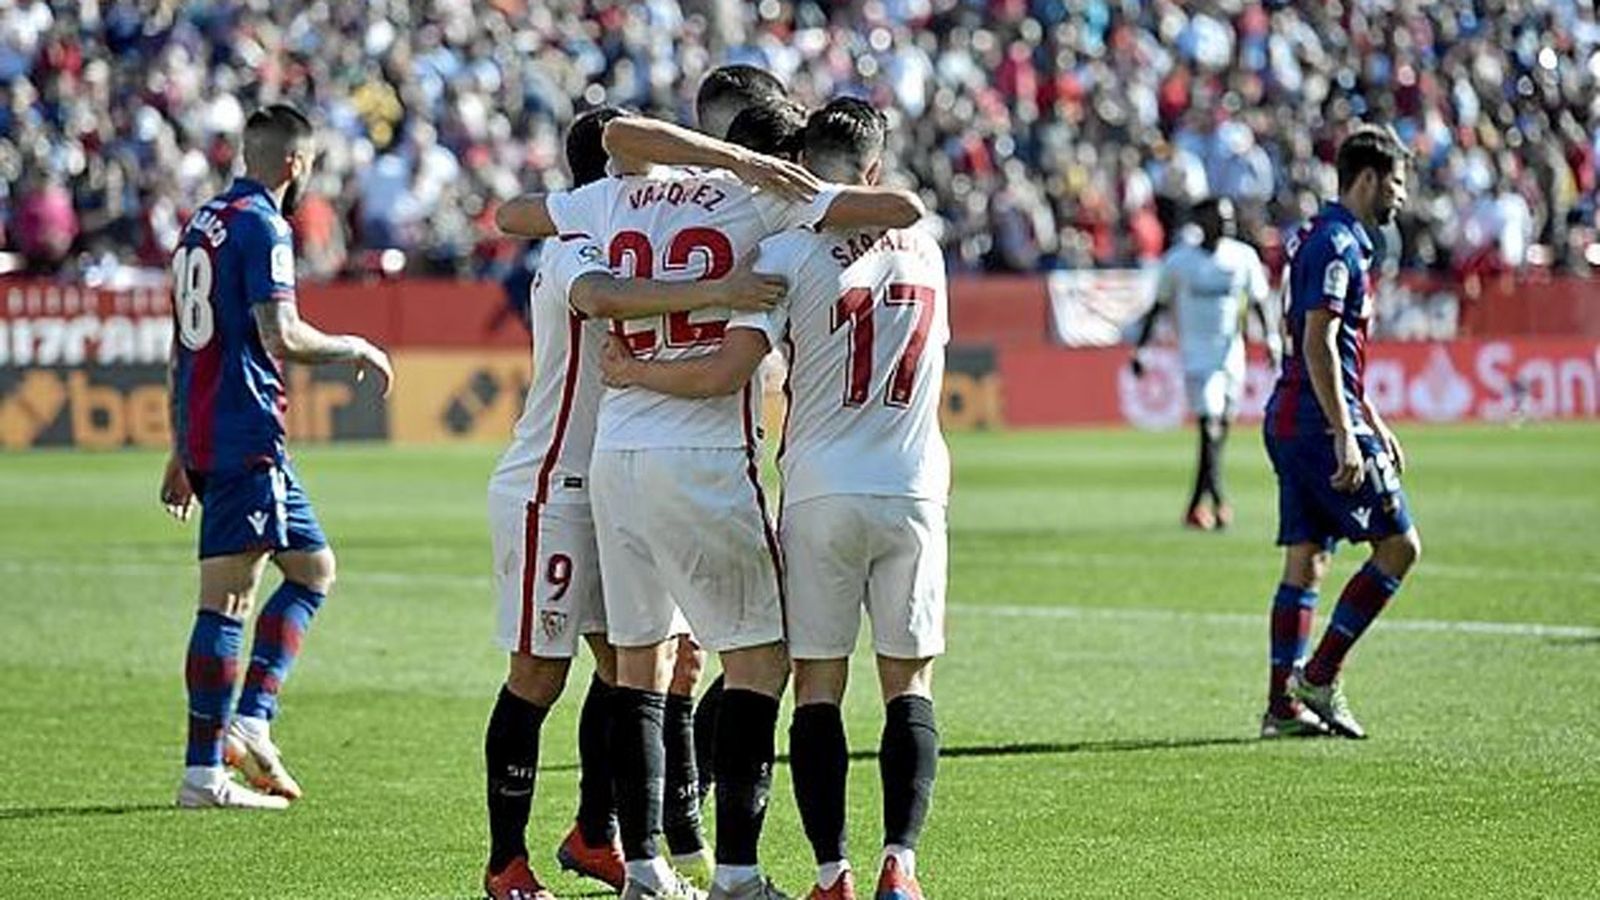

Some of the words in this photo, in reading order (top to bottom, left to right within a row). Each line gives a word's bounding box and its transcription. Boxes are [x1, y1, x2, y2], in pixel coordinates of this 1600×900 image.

[172, 246, 215, 352] 18
[608, 226, 735, 361] 22
[830, 282, 936, 409] 17
[1476, 342, 1600, 417] San
[1364, 451, 1401, 494] 12
[546, 552, 573, 602] 9
